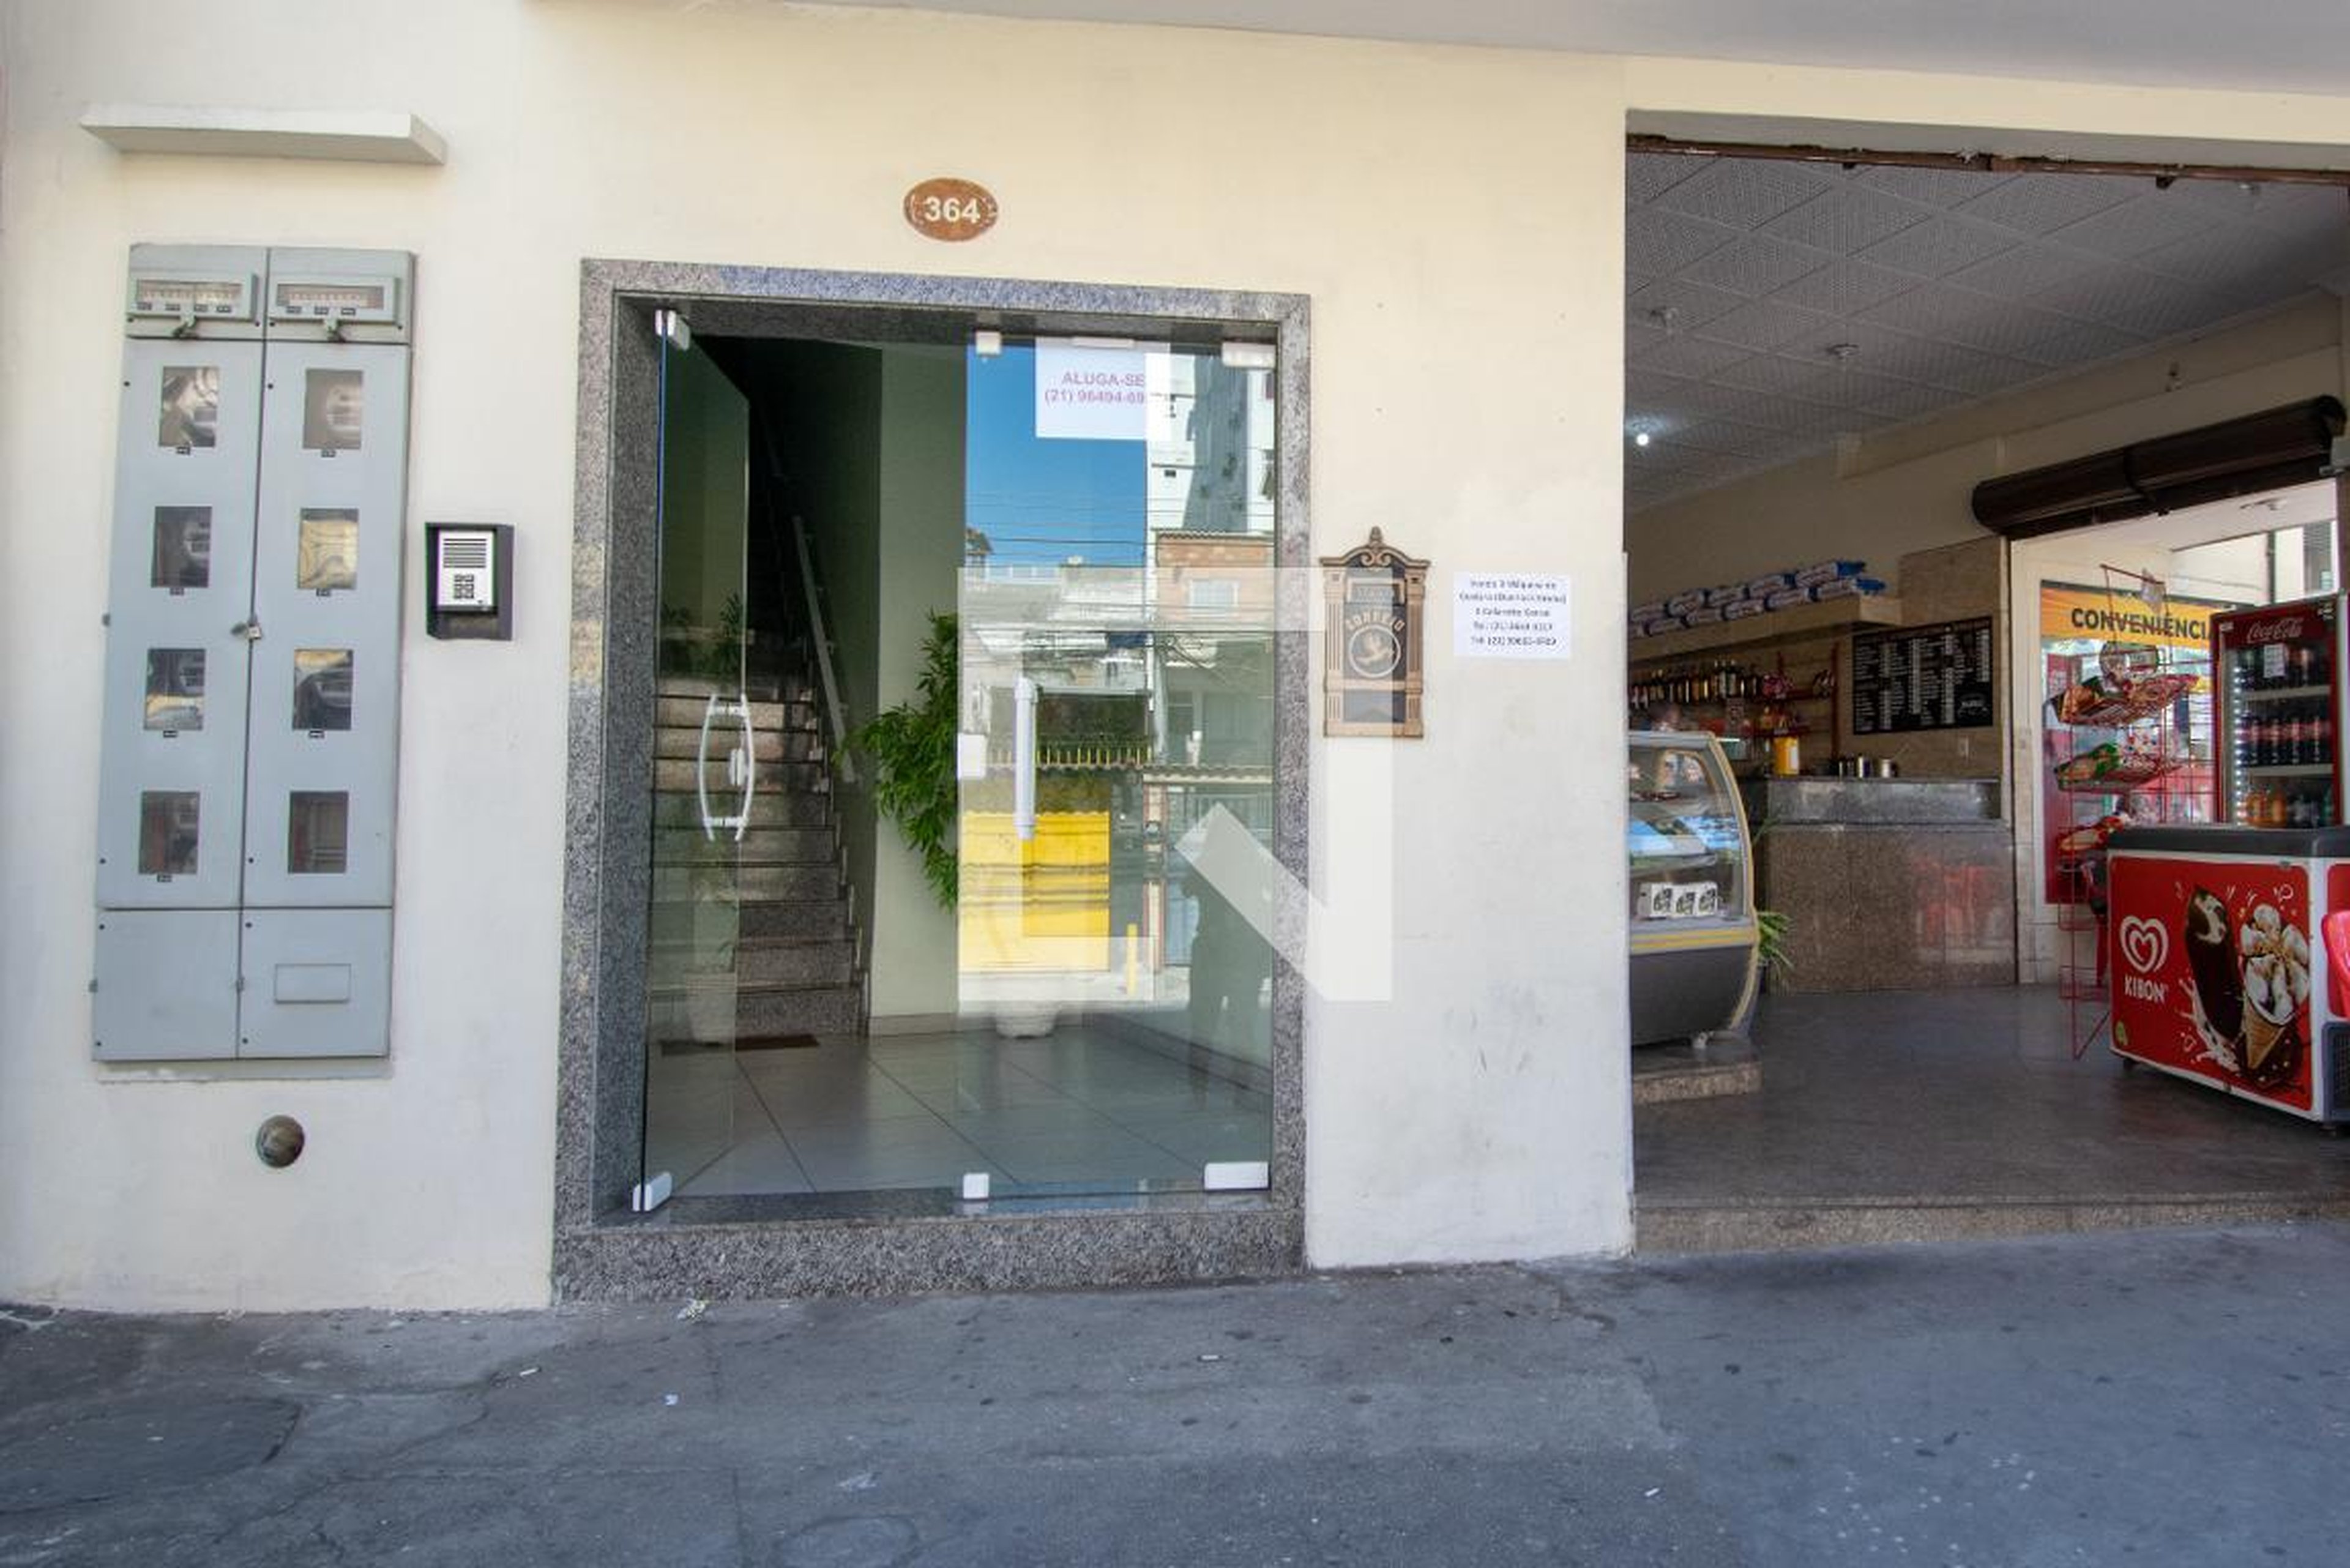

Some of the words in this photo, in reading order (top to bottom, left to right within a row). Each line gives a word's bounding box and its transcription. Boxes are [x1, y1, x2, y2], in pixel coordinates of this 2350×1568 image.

[923, 196, 980, 224] 364
[1062, 371, 1145, 387] ALUGA-SE
[2125, 973, 2165, 1004] KIBON
